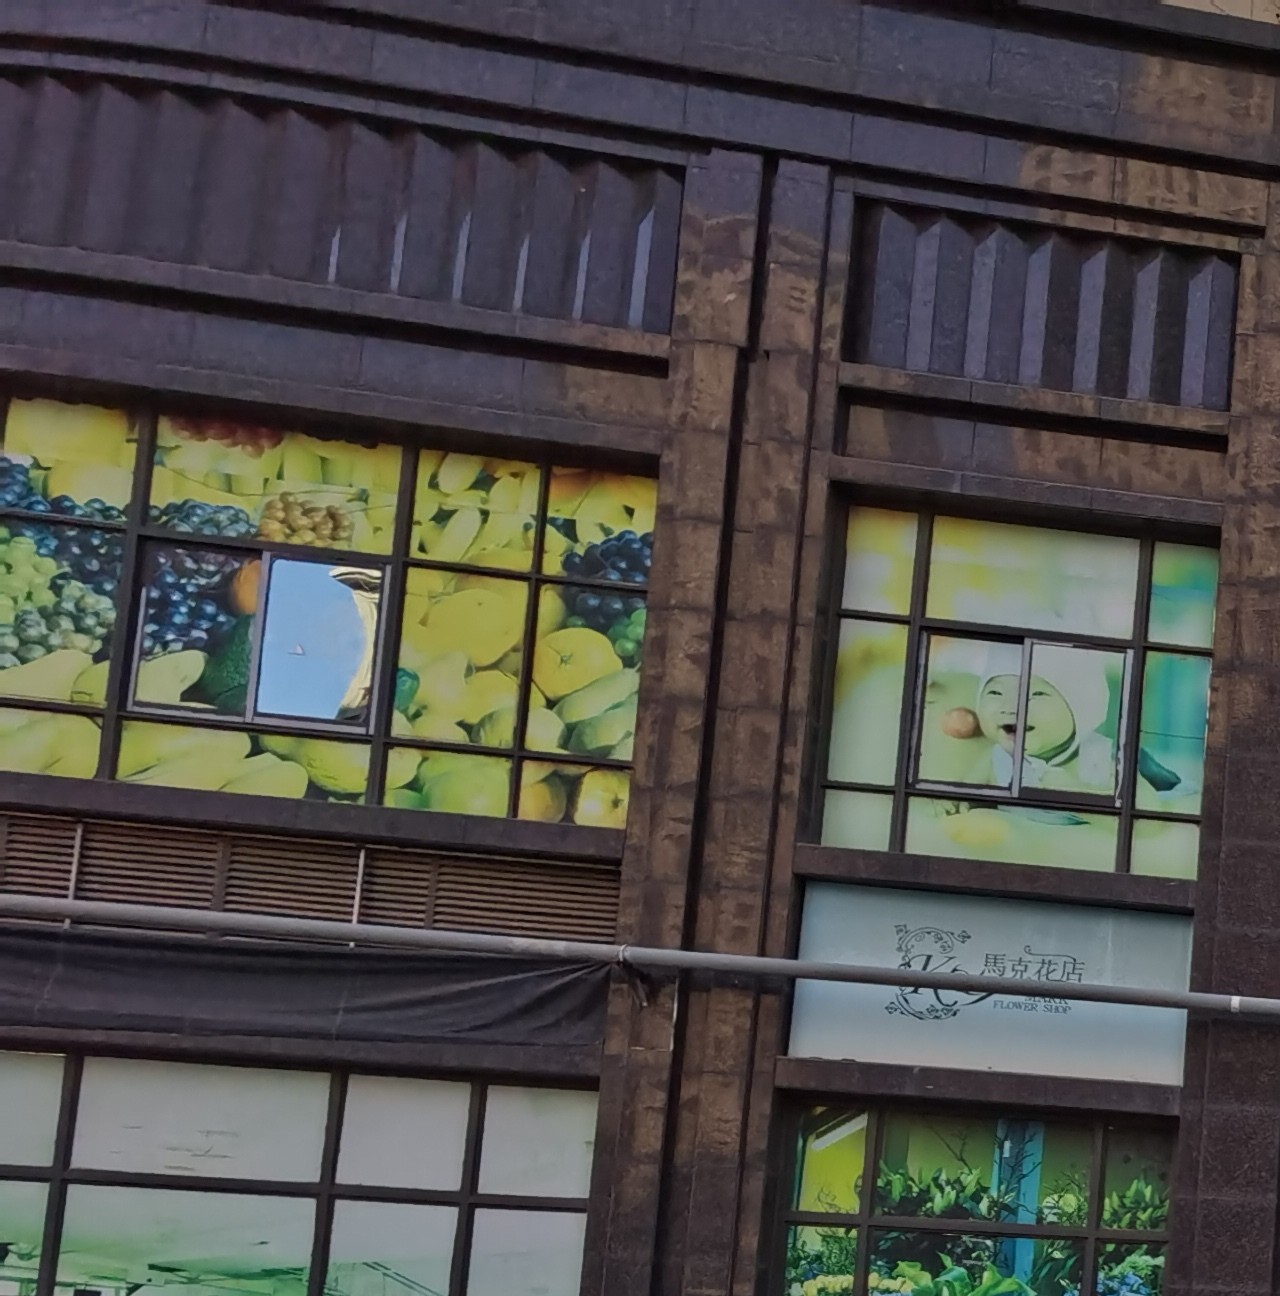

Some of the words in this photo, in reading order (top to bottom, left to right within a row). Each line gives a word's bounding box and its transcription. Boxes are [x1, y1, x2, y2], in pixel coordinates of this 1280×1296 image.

[980, 953, 1085, 983] 馬克花店
[993, 1000, 1038, 1012] FLOWER
[1043, 1004, 1072, 1014] SHOP
